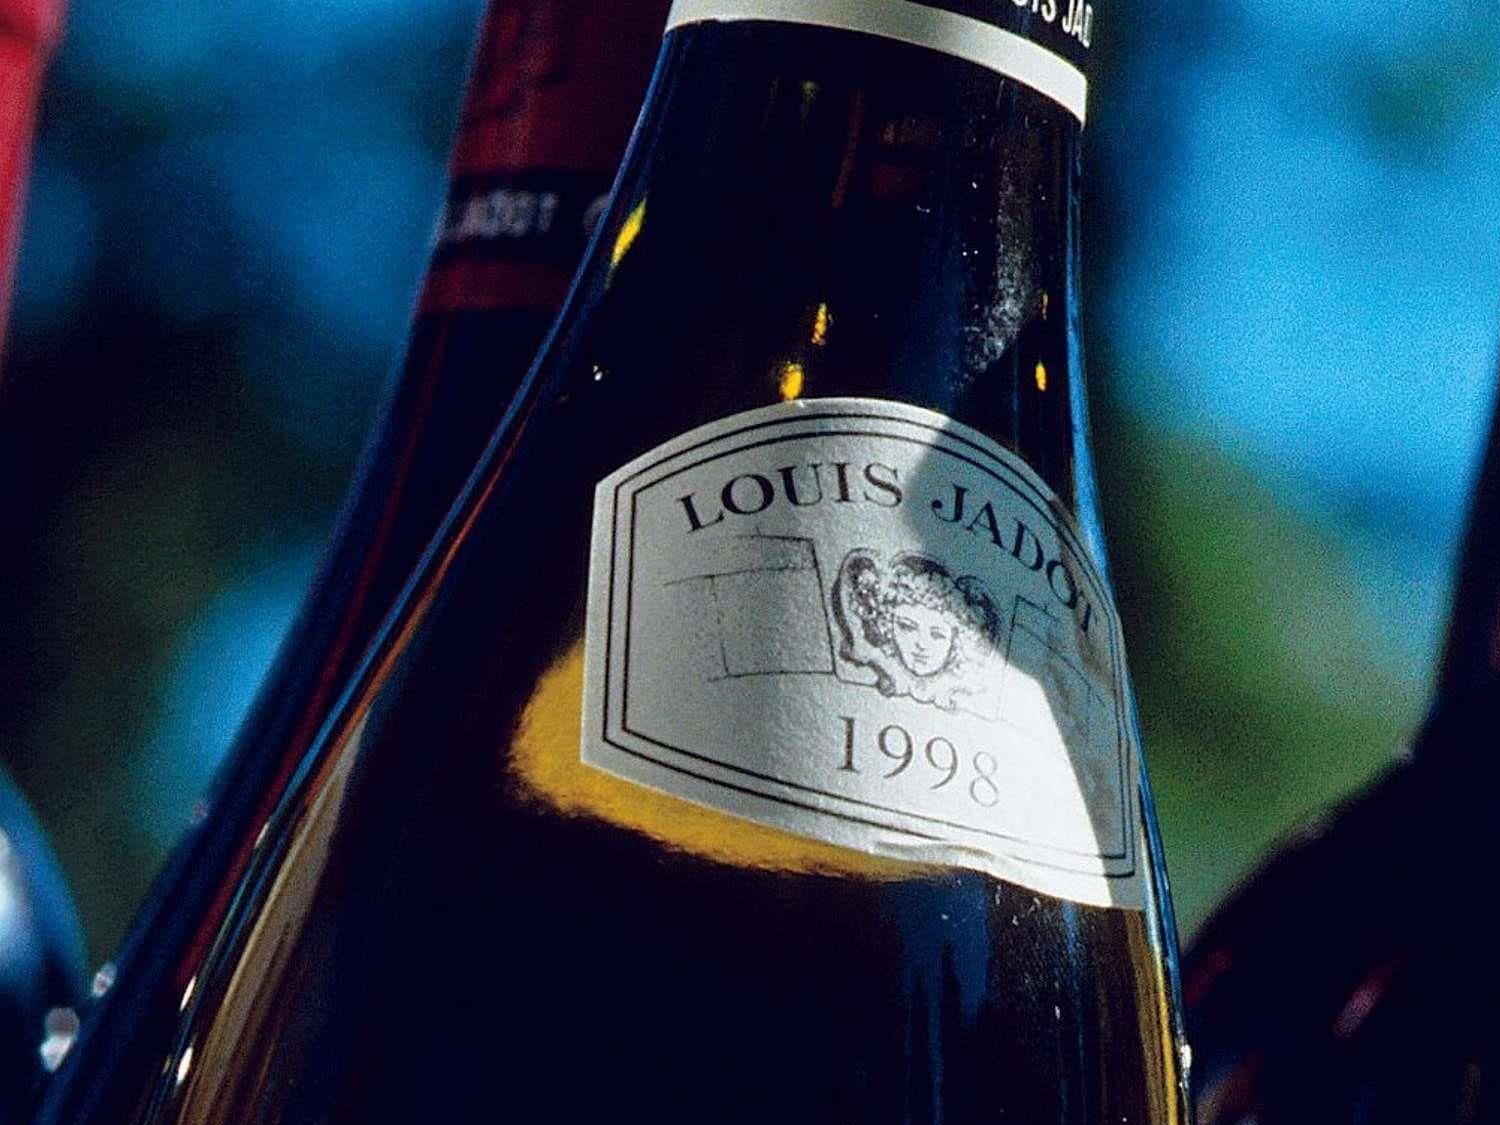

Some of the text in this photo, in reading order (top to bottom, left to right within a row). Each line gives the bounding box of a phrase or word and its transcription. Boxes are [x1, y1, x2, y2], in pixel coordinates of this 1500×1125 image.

[676, 461, 1100, 634] LOUIS JADOT
[836, 715, 1001, 809] 1998
